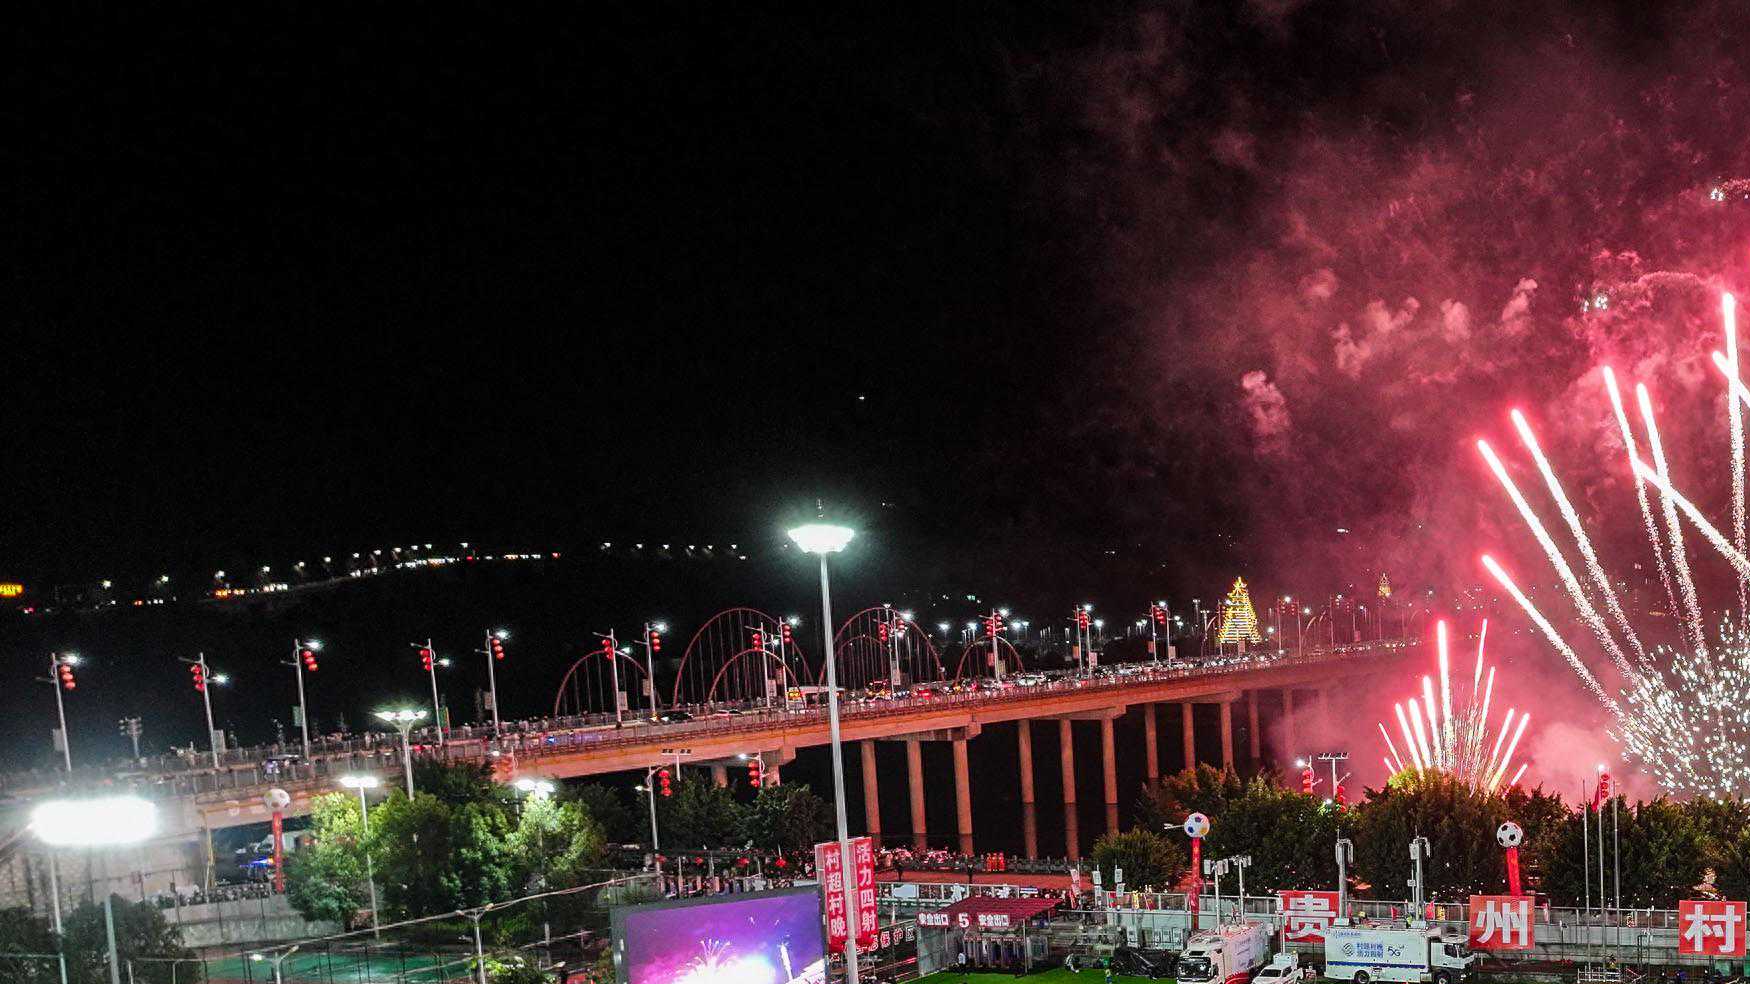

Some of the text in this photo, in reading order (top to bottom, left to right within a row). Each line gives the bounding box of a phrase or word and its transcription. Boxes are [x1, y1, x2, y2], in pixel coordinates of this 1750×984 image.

[856, 843, 877, 932] 活力四射
[919, 913, 1009, 928] 安全出口 5 安全出口
[1284, 894, 1336, 939] 贵
[1475, 902, 1530, 947] 州
[1683, 904, 1736, 954] 村
